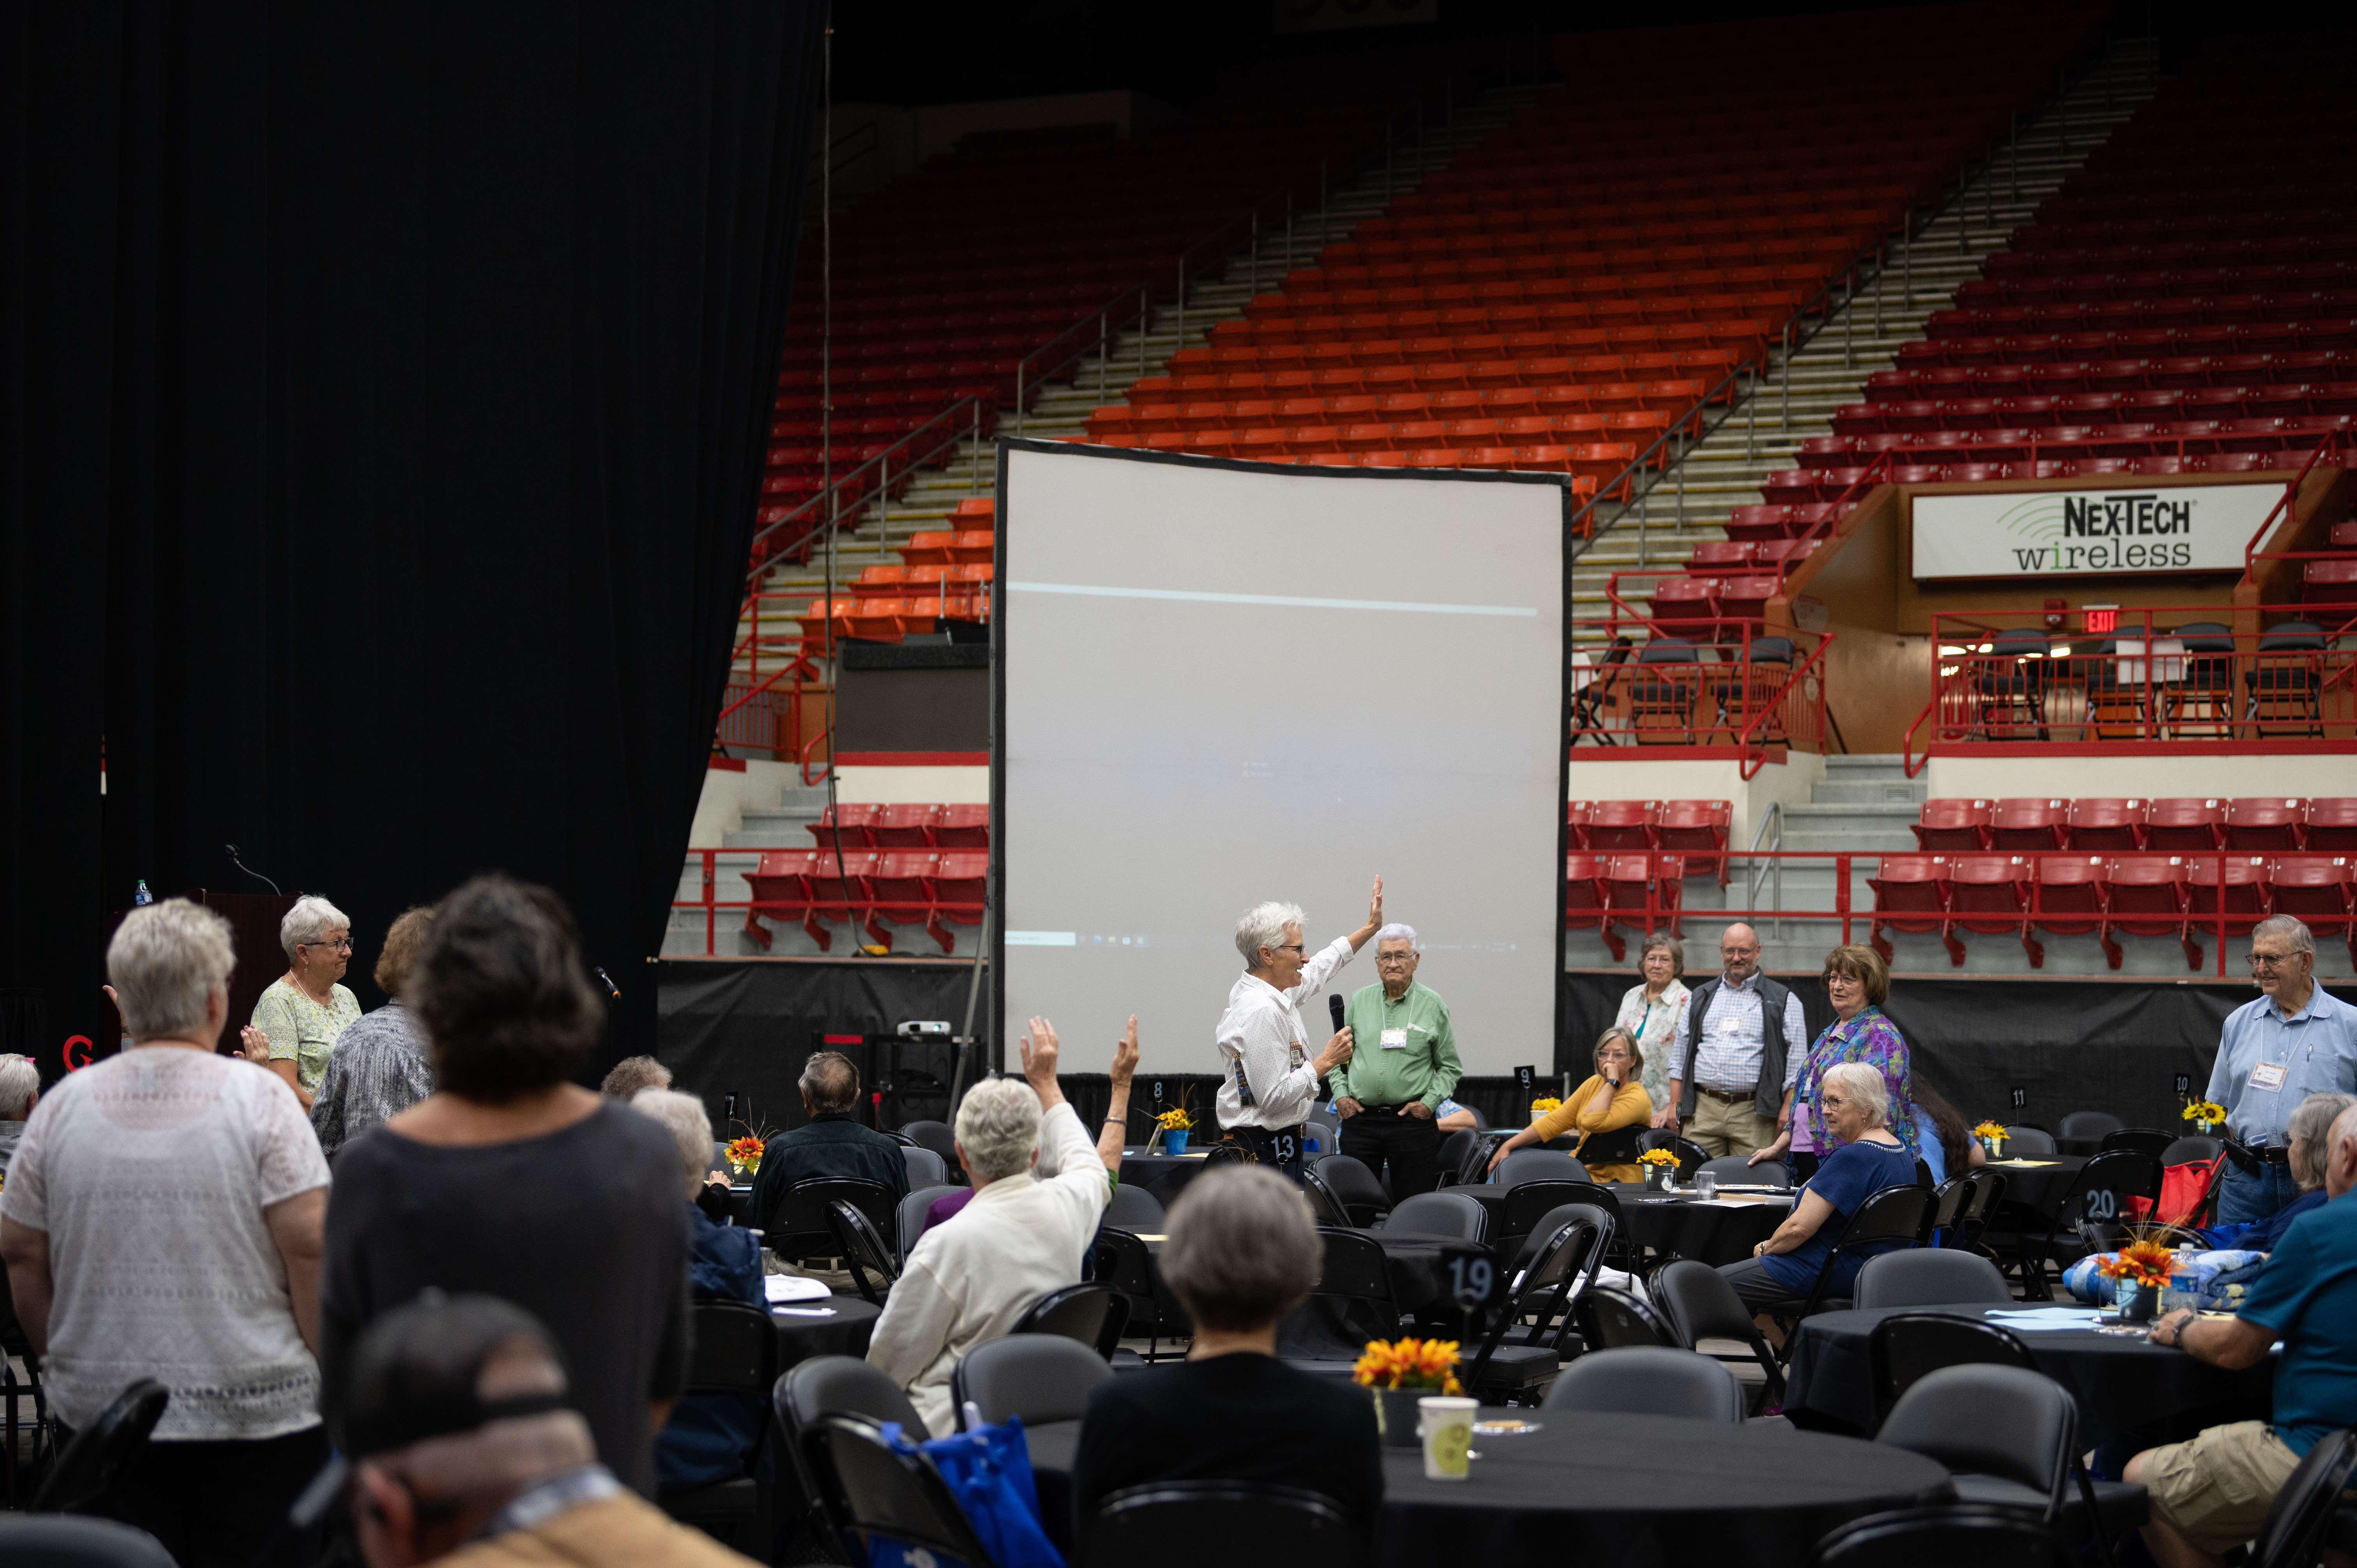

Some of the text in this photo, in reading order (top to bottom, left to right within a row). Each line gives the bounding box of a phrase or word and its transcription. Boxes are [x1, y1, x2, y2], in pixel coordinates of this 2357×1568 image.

[2012, 538, 2191, 571] wireless
[2088, 612, 2114, 633] EXIT
[63, 1035, 93, 1073] G
[1521, 1068, 1529, 1083] 9
[2177, 1076, 2188, 1091] 10
[1154, 1082, 1162, 1097] 8
[2013, 1089, 2023, 1106] 11
[730, 1096, 735, 1113] 7
[1271, 1135, 1294, 1158] 13
[2087, 1190, 2115, 1218] 20
[1449, 1256, 1493, 1302] 19
